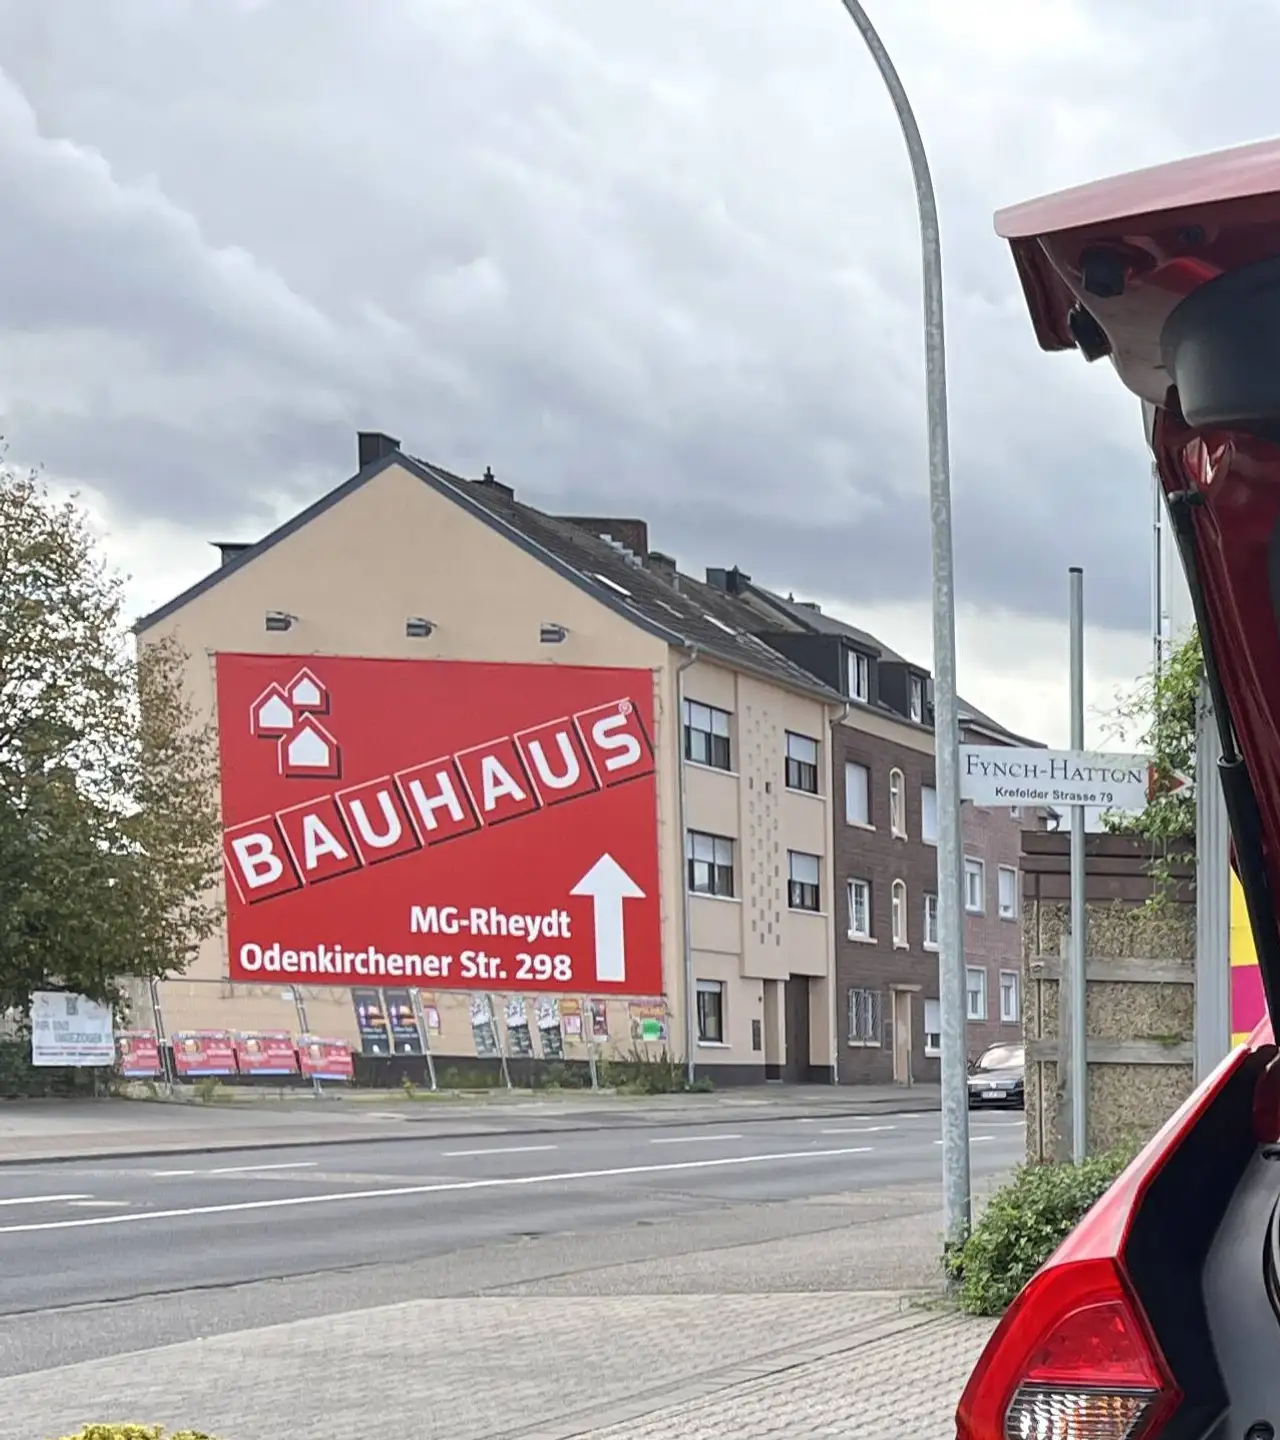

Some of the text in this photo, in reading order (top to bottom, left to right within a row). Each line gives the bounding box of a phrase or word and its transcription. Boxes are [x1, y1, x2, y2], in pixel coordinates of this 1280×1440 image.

[965, 753, 1143, 784] FYNCH-HATTON
[231, 713, 641, 889] BAUHAUS
[995, 786, 1114, 803] Krefelder Strasse 79
[410, 905, 572, 943] MG-Rheydt
[239, 943, 573, 981] Odenkirchener Str. 298
